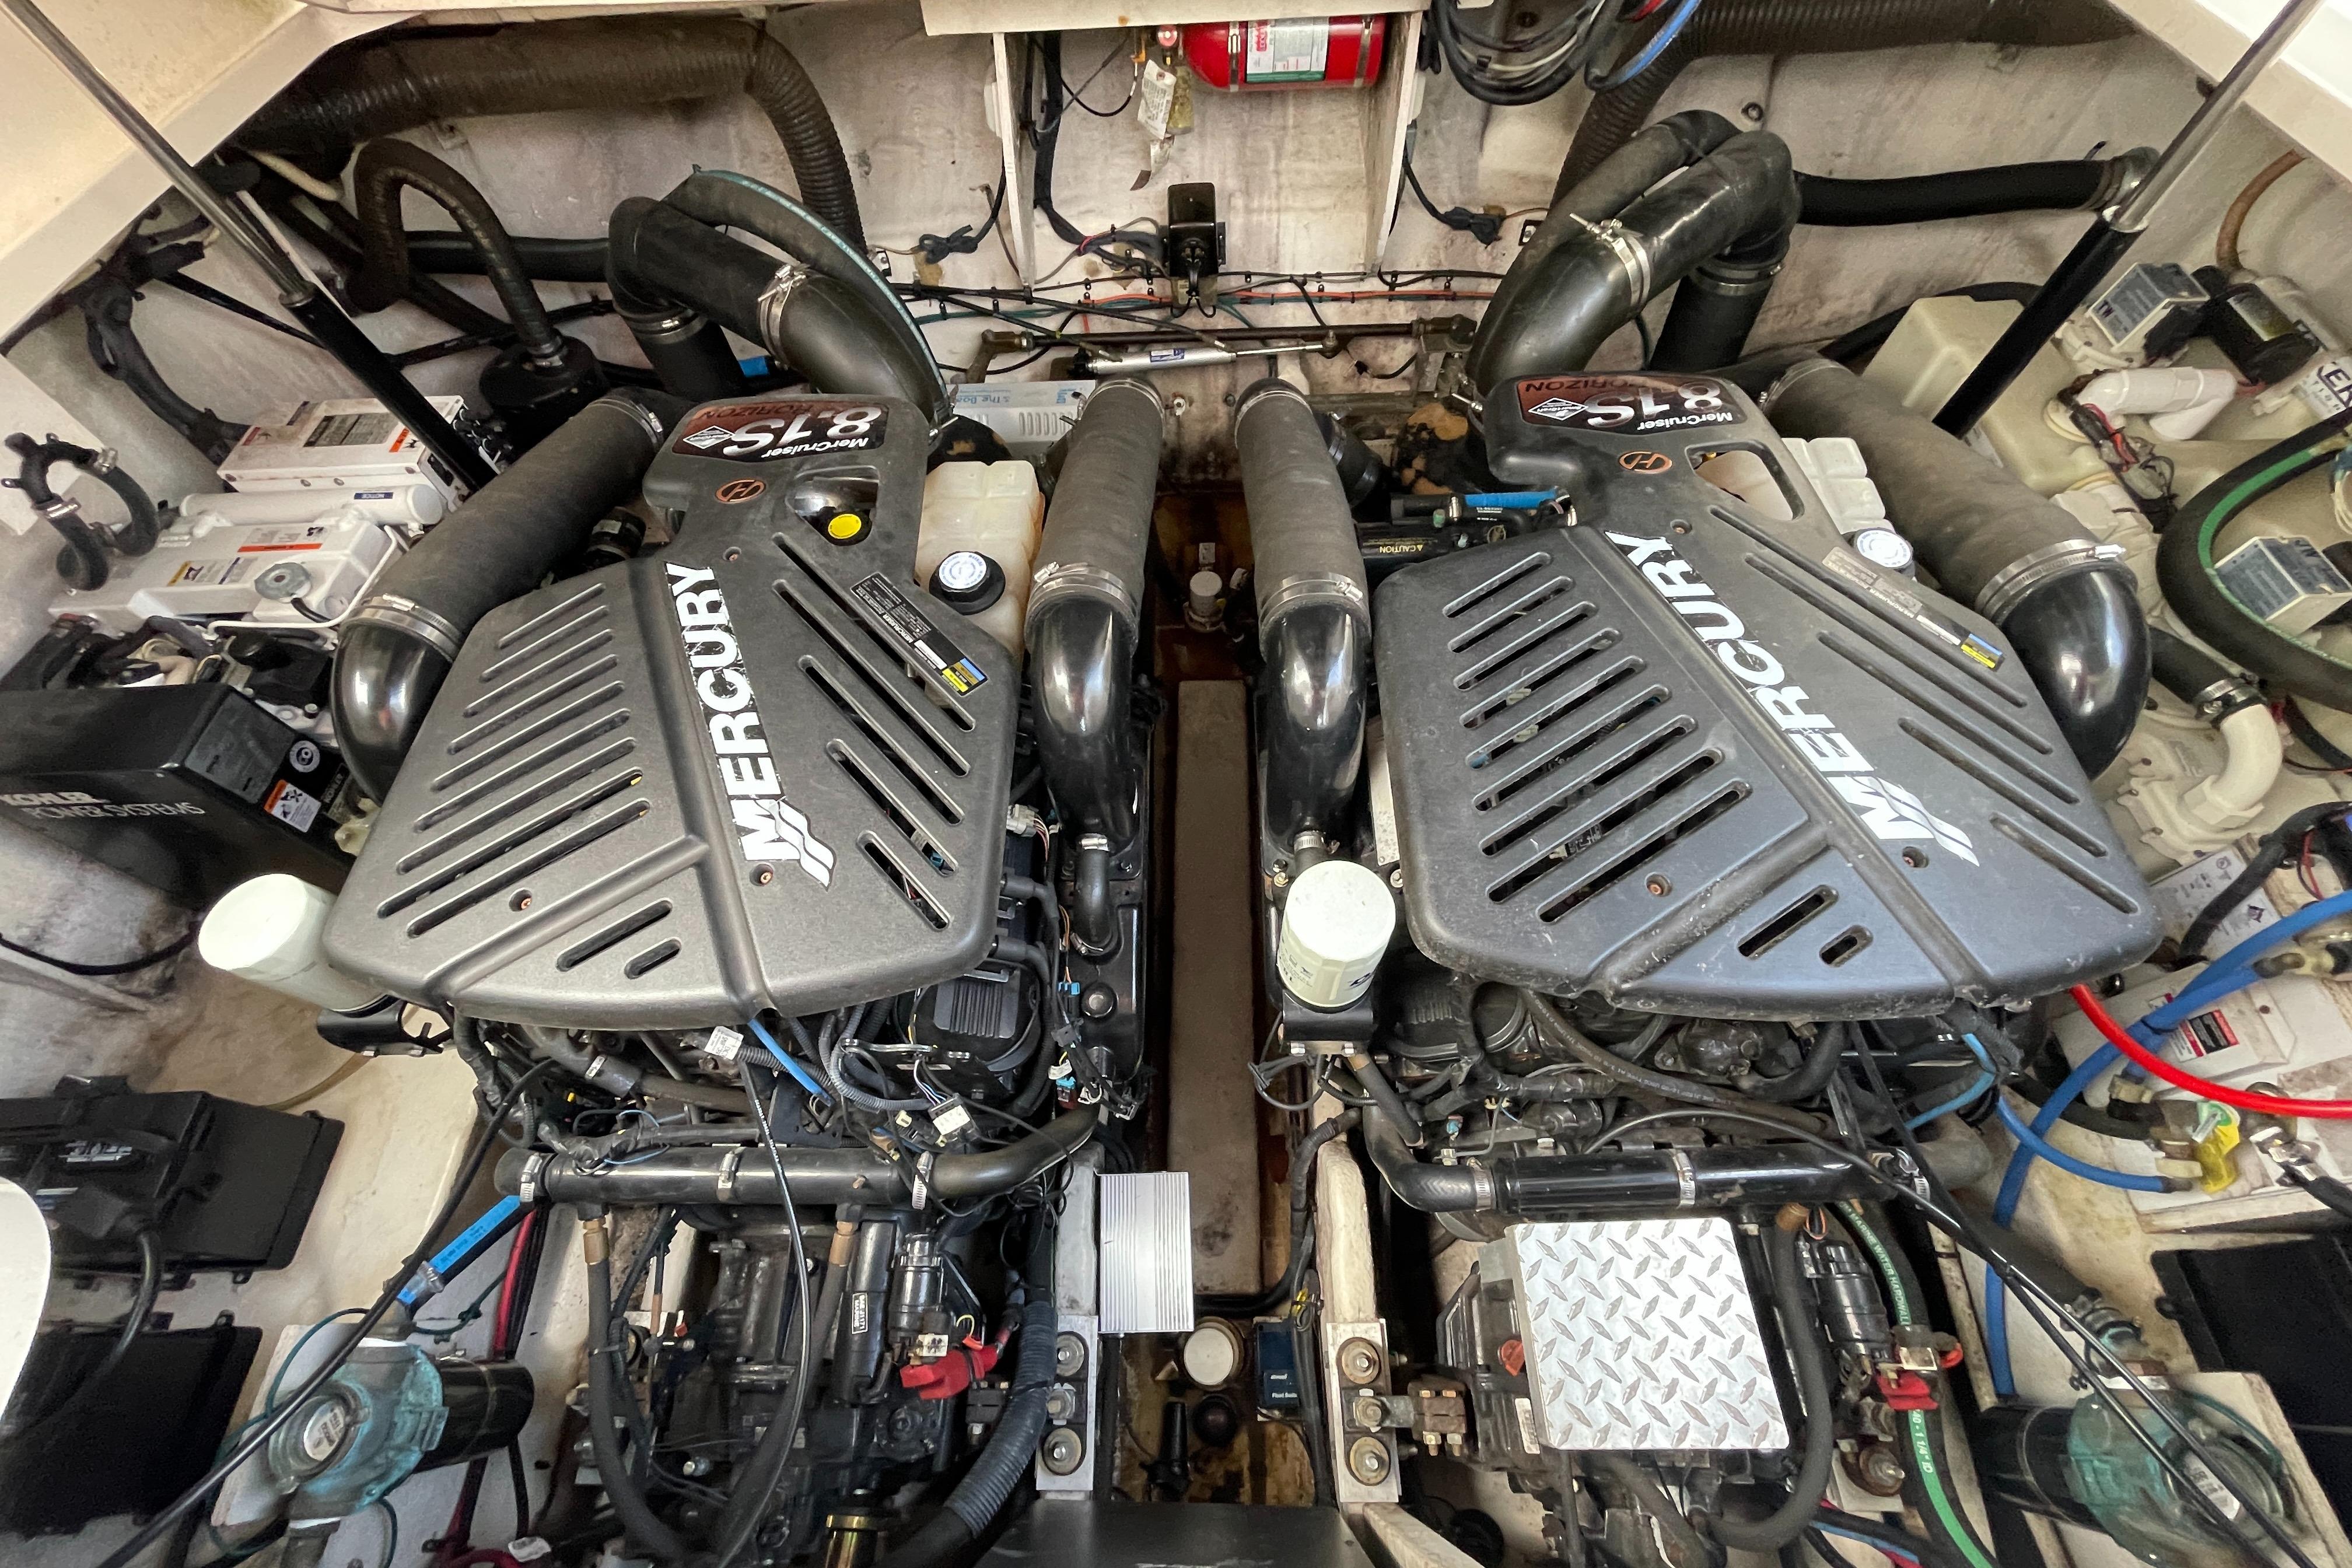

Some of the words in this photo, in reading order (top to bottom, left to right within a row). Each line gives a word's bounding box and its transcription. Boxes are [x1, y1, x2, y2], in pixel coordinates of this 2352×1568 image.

[723, 407, 882, 456] 8.1S
[1637, 412, 1733, 430] MerCruiser
[761, 438, 869, 458] MerCruiser
[883, 612, 914, 643] MERCRUISER
[1605, 531, 1979, 867] MERCURY
[667, 563, 830, 887] MERCURY
[104, 802, 206, 817] SYSTEMS
[1850, 1213, 1877, 1246] MARINE
[1873, 1244, 1895, 1277] WATER
[1922, 1461, 1933, 1474] ID
